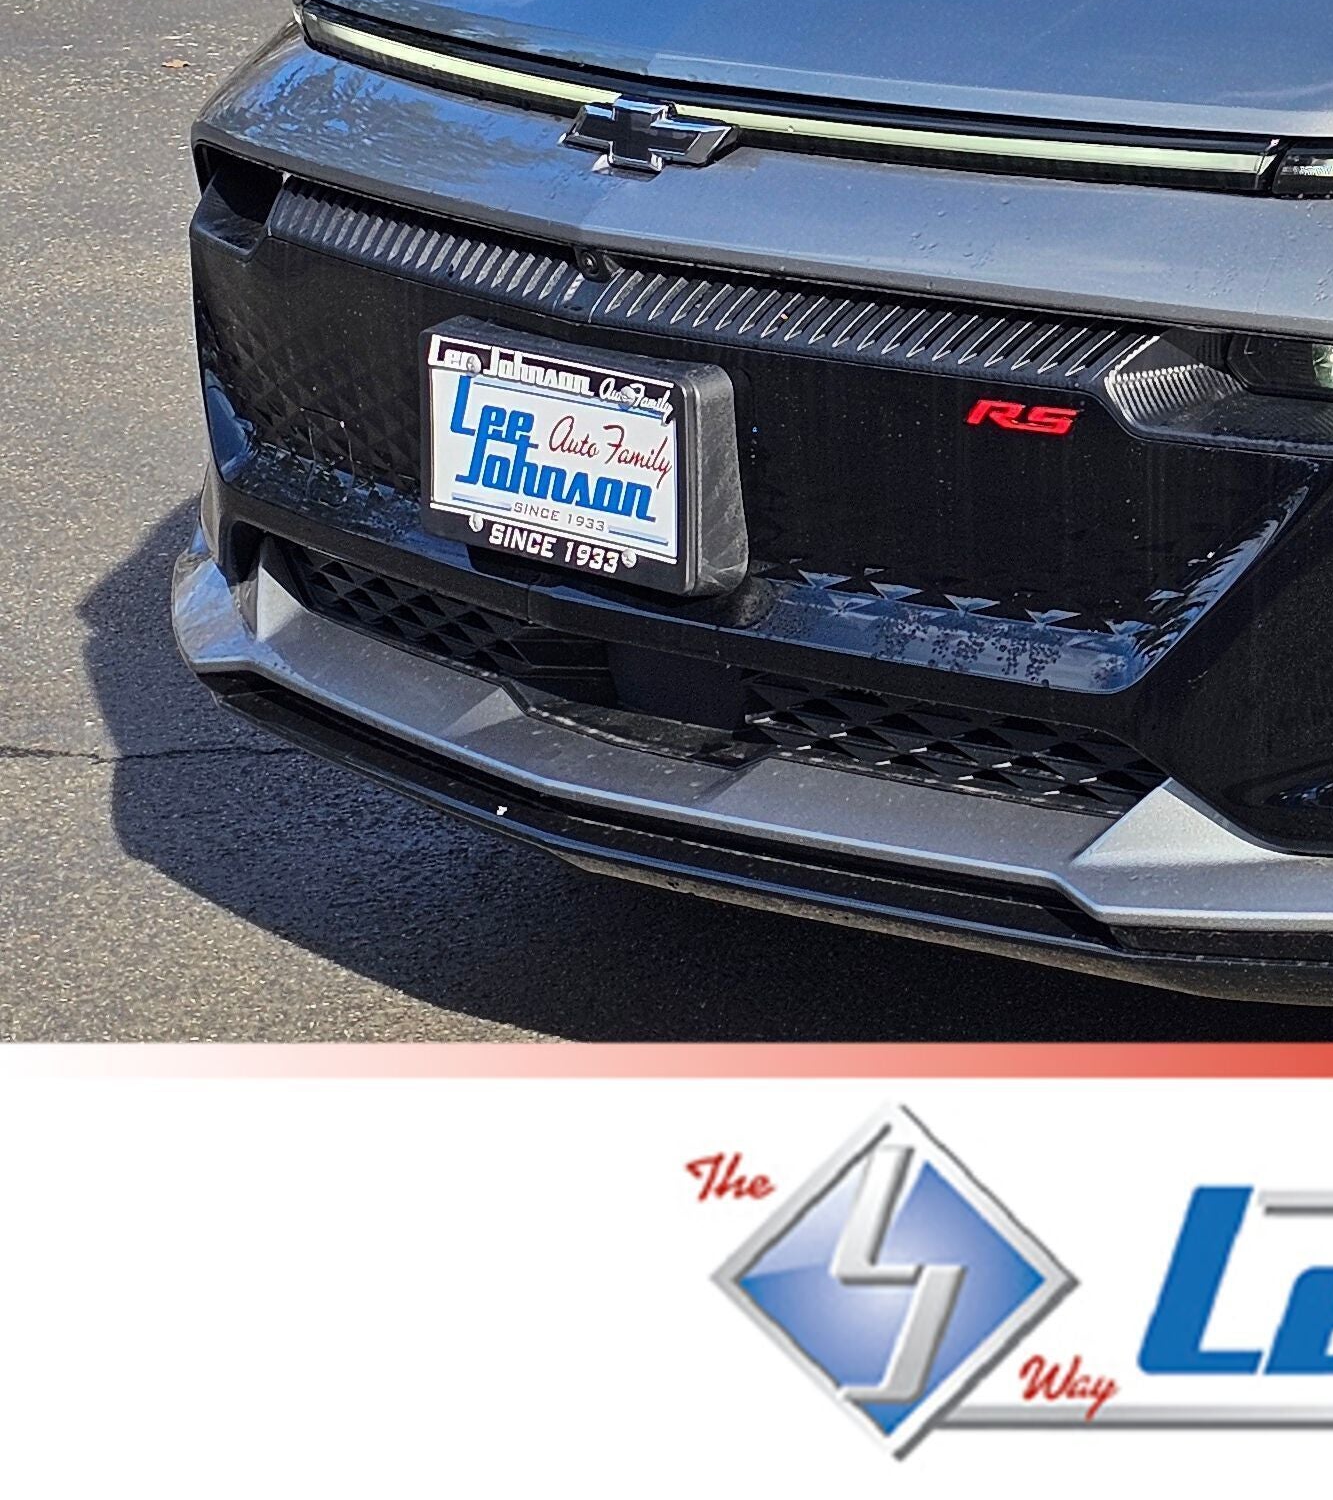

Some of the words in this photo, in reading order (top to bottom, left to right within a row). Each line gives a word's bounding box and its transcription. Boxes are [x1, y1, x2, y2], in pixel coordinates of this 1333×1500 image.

[483, 346, 595, 397] Johnson
[450, 375, 539, 450] Lee
[966, 398, 1079, 436] RS
[548, 415, 599, 459] Auto
[602, 424, 673, 489] Family
[454, 435, 657, 523] Johnson
[513, 501, 561, 522] SINCE
[566, 513, 606, 533] 1933
[488, 522, 557, 558] SINCE
[564, 540, 620, 574] 1933
